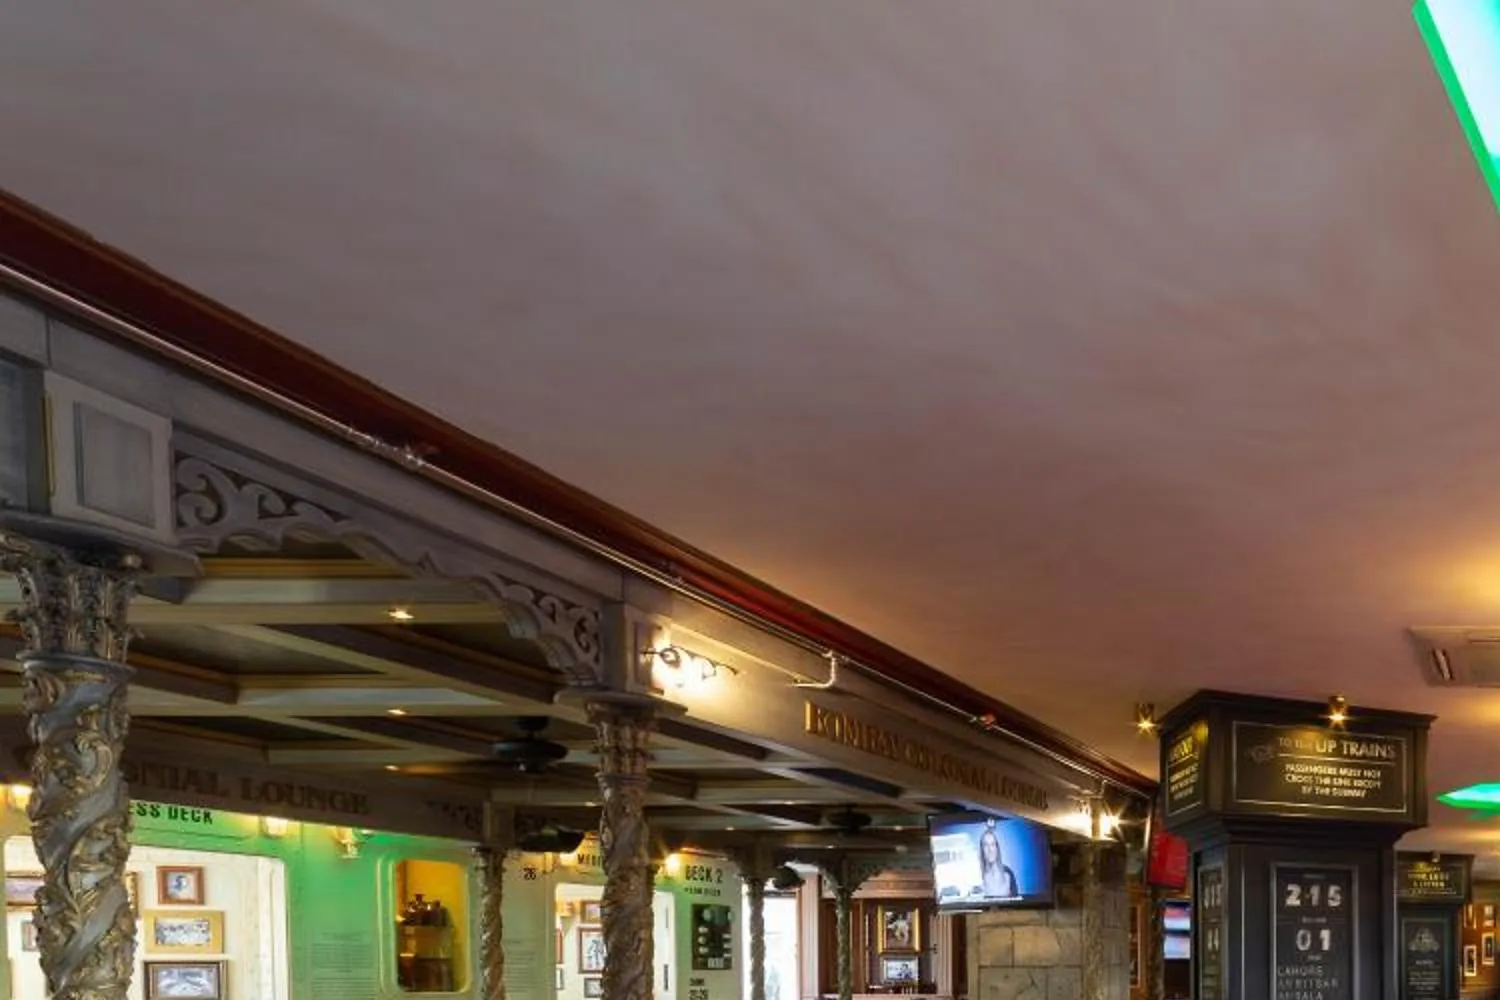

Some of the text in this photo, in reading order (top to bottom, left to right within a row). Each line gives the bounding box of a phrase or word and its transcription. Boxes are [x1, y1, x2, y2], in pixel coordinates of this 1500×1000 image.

[1315, 737, 1337, 753] UP
[1340, 740, 1395, 760] TRAINS
[239, 777, 370, 815] LOUNGE
[167, 806, 213, 825] DECK
